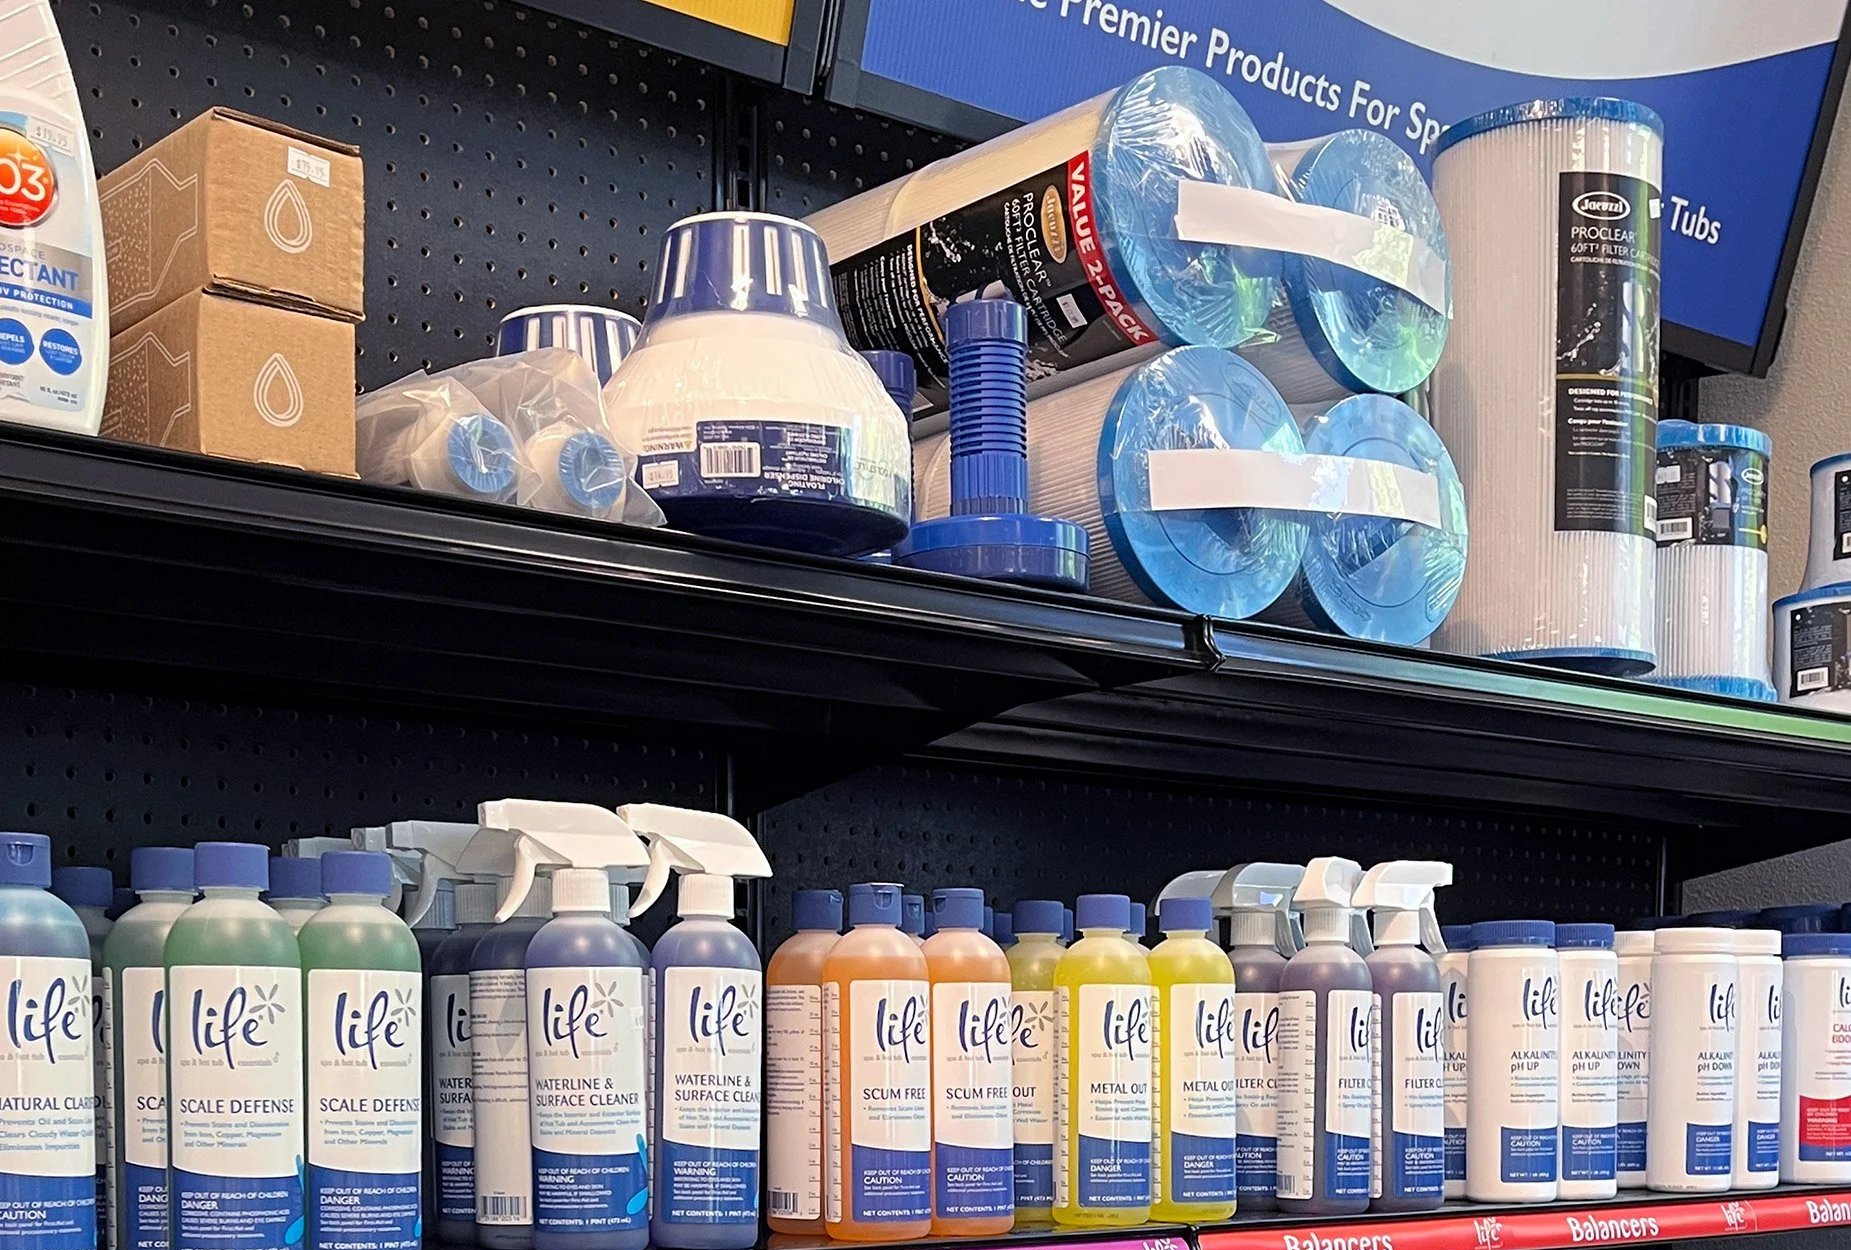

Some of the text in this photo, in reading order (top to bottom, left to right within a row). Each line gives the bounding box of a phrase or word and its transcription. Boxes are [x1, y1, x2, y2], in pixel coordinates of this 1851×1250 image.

[1060, 0, 1198, 59] Premier
[1205, 27, 1342, 111] Products
[1348, 79, 1401, 130] For
[1670, 195, 1722, 245] Tubs
[1580, 198, 1625, 214] Jacuzzi
[1046, 194, 1066, 260] Jacuzzi
[1069, 160, 1151, 345] VALUE 2-PACK
[1601, 244, 1628, 257] FILTER
[1013, 235, 1068, 343] FILTER CARTRIDGE
[12, 288, 74, 310] PROTECTION
[7, 977, 83, 1064] life
[191, 985, 268, 1070] life
[543, 985, 609, 1059] life
[690, 985, 750, 1058] life
[334, 991, 404, 1070] life
[877, 997, 925, 1065] life
[959, 998, 1009, 1065] life
[1103, 998, 1149, 1063] life
[1195, 998, 1235, 1060] life
[1510, 1061, 1540, 1074] pH UP
[1572, 1061, 1601, 1074] pH UP
[1697, 1062, 1710, 1074] pH
[534, 1077, 601, 1092] WATERLINE
[675, 1073, 743, 1088] WATERLINE
[1183, 1080, 1220, 1093] METAL
[1338, 1078, 1365, 1090] FILTER
[1405, 1078, 1435, 1090] FILTER
[674, 1088, 729, 1104] SURFACE
[863, 1086, 926, 1101] SCUM FREE
[946, 1085, 1009, 1100] SCUM FREE
[1013, 1085, 1037, 1099] OUT
[1090, 1082, 1148, 1095] METAL OUT
[180, 1098, 294, 1114] SCALE DEFENSE
[319, 1097, 420, 1113] SCALE DEFENSE
[535, 1092, 640, 1108] SURFACE CLEANER
[1510, 1139, 1541, 1148] CAUTION
[1571, 1138, 1602, 1147] CAUTION
[1695, 1135, 1720, 1143] DANGER
[1337, 1153, 1365, 1162] CAUTION
[1404, 1152, 1435, 1161] CAUTION
[673, 1167, 716, 1177] WARNING
[1090, 1164, 1122, 1173] DANGER
[1184, 1161, 1215, 1170] DANGER
[538, 1174, 575, 1184] WARNING
[863, 1176, 903, 1186] CAUTION
[947, 1173, 985, 1183] CAUTION
[181, 1199, 218, 1211] DANGER
[319, 1195, 361, 1206] DANGER
[1566, 1215, 1660, 1243] Balancers
